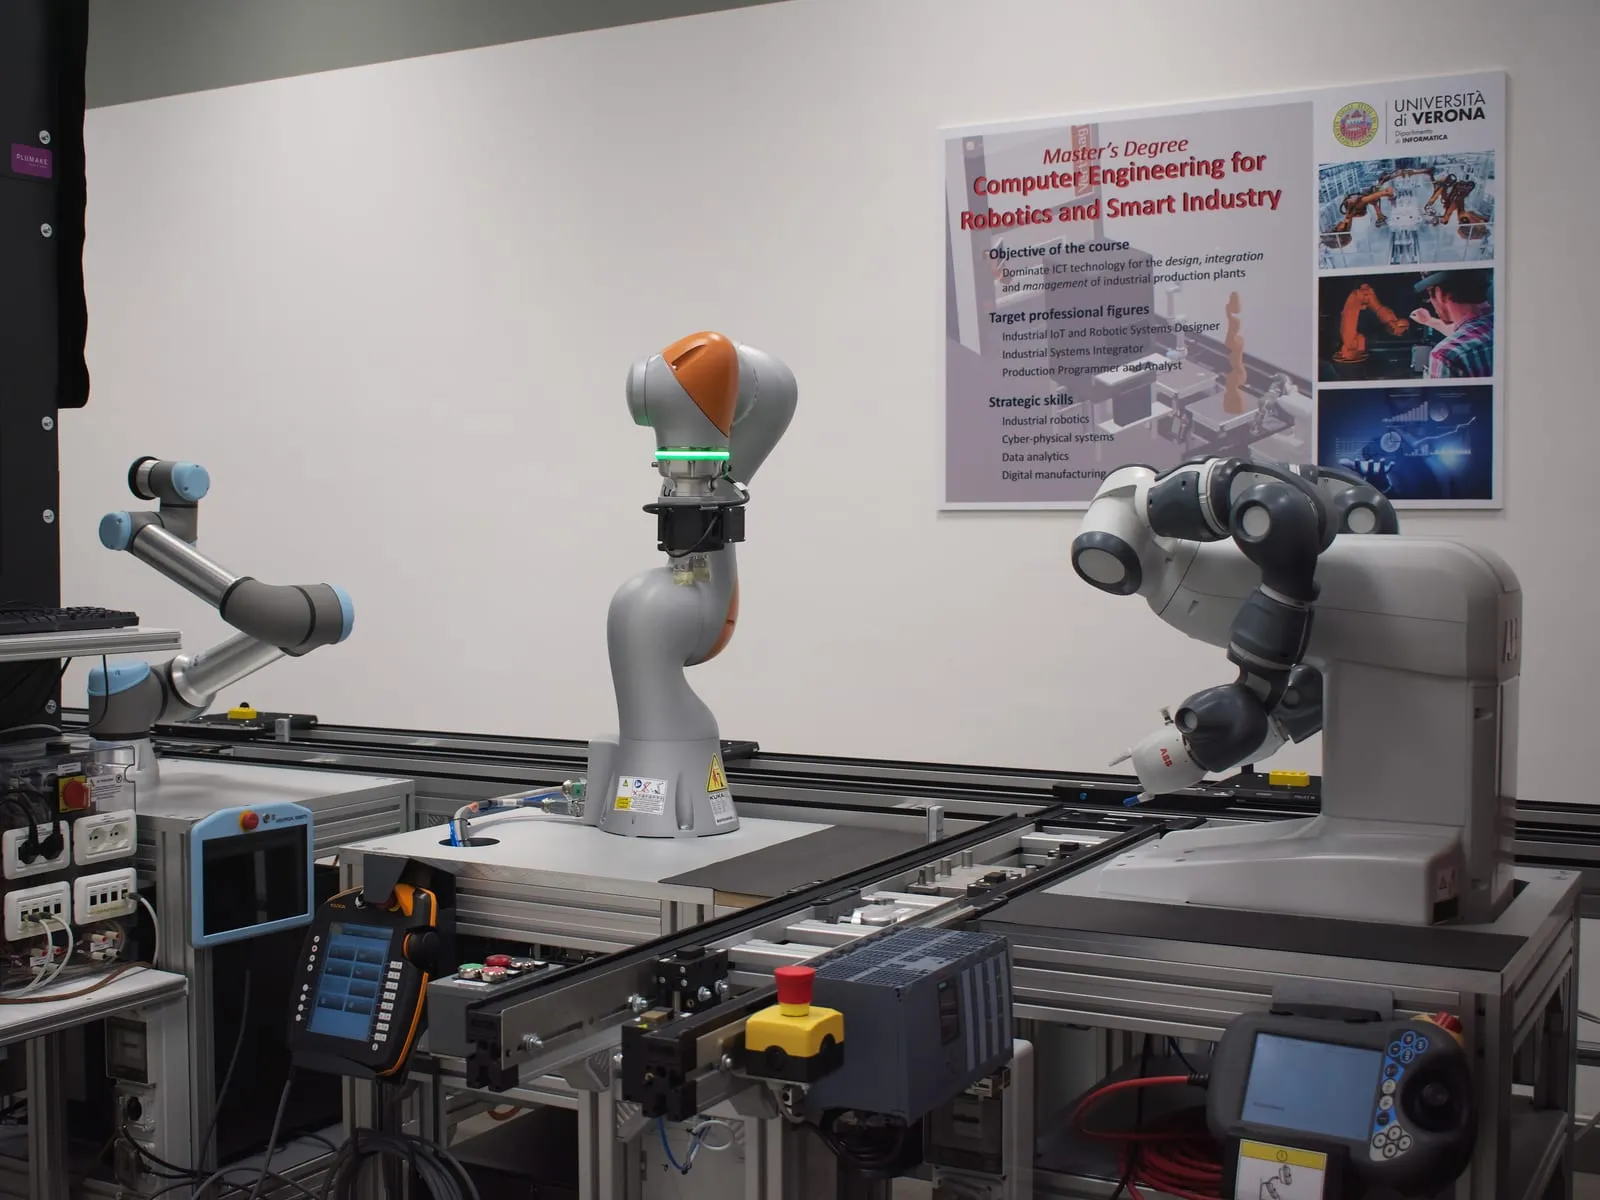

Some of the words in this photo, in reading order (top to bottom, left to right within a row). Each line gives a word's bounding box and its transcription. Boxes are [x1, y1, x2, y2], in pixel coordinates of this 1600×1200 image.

[1394, 90, 1486, 112] UNIVERSITÀ
[1394, 113, 1407, 127] di
[1412, 107, 1486, 125] VERONA
[1402, 134, 1448, 143] INFORMATICA
[1043, 142, 1119, 165] Master's
[1124, 139, 1189, 158] Degree
[973, 170, 1083, 196] Computer
[1089, 156, 1226, 188] Engineering
[1231, 151, 1267, 173] for
[960, 205, 1053, 231] Robotics
[1059, 198, 1101, 221] and
[1107, 195, 1176, 219] Smart
[1182, 188, 1282, 211] Industry
[989, 246, 1046, 261] Objective
[1049, 243, 1063, 255] of
[1065, 242, 1085, 254] the
[1088, 241, 1130, 252] course
[1002, 266, 1050, 278] Dominate
[1052, 264, 1067, 274] ICT
[1070, 259, 1126, 273] technology
[1128, 258, 1144, 269] for
[1146, 257, 1162, 268] the
[1165, 255, 1202, 268] design,
[1205, 251, 1264, 265] integration
[1002, 282, 1020, 293] and
[1022, 279, 1088, 291] management
[1090, 276, 1102, 287] of
[1103, 274, 1151, 286] industrial
[1153, 271, 1211, 284] production
[1213, 268, 1246, 281] plants
[989, 311, 1026, 325] Target
[1029, 305, 1103, 323] professional
[1107, 305, 1150, 319] figures
[1002, 330, 1048, 342] Industrial
[1050, 328, 1067, 339] IoT
[1068, 327, 1087, 338] and
[1089, 326, 1128, 337] Robotic
[1130, 324, 1172, 336] Systems
[1174, 322, 1220, 334] Designer
[1002, 347, 1048, 359] Industrial
[1050, 347, 1091, 359] Systems
[1093, 344, 1144, 357] Integrator
[1002, 366, 1055, 377] Production
[1058, 364, 1120, 377] Programmer
[1122, 361, 1142, 372] and
[1144, 361, 1182, 372] Analyst
[989, 395, 1041, 409] Strategic
[1044, 394, 1074, 406] skills
[1002, 416, 1048, 426] Industrial
[1050, 413, 1090, 425] robotics
[1002, 432, 1072, 446] Cyber-physical
[1075, 432, 1115, 443] systems
[1002, 452, 1024, 463] Data
[1027, 451, 1069, 464] analytics
[1002, 470, 1033, 481] Digital
[1159, 747, 1173, 768] ABB
